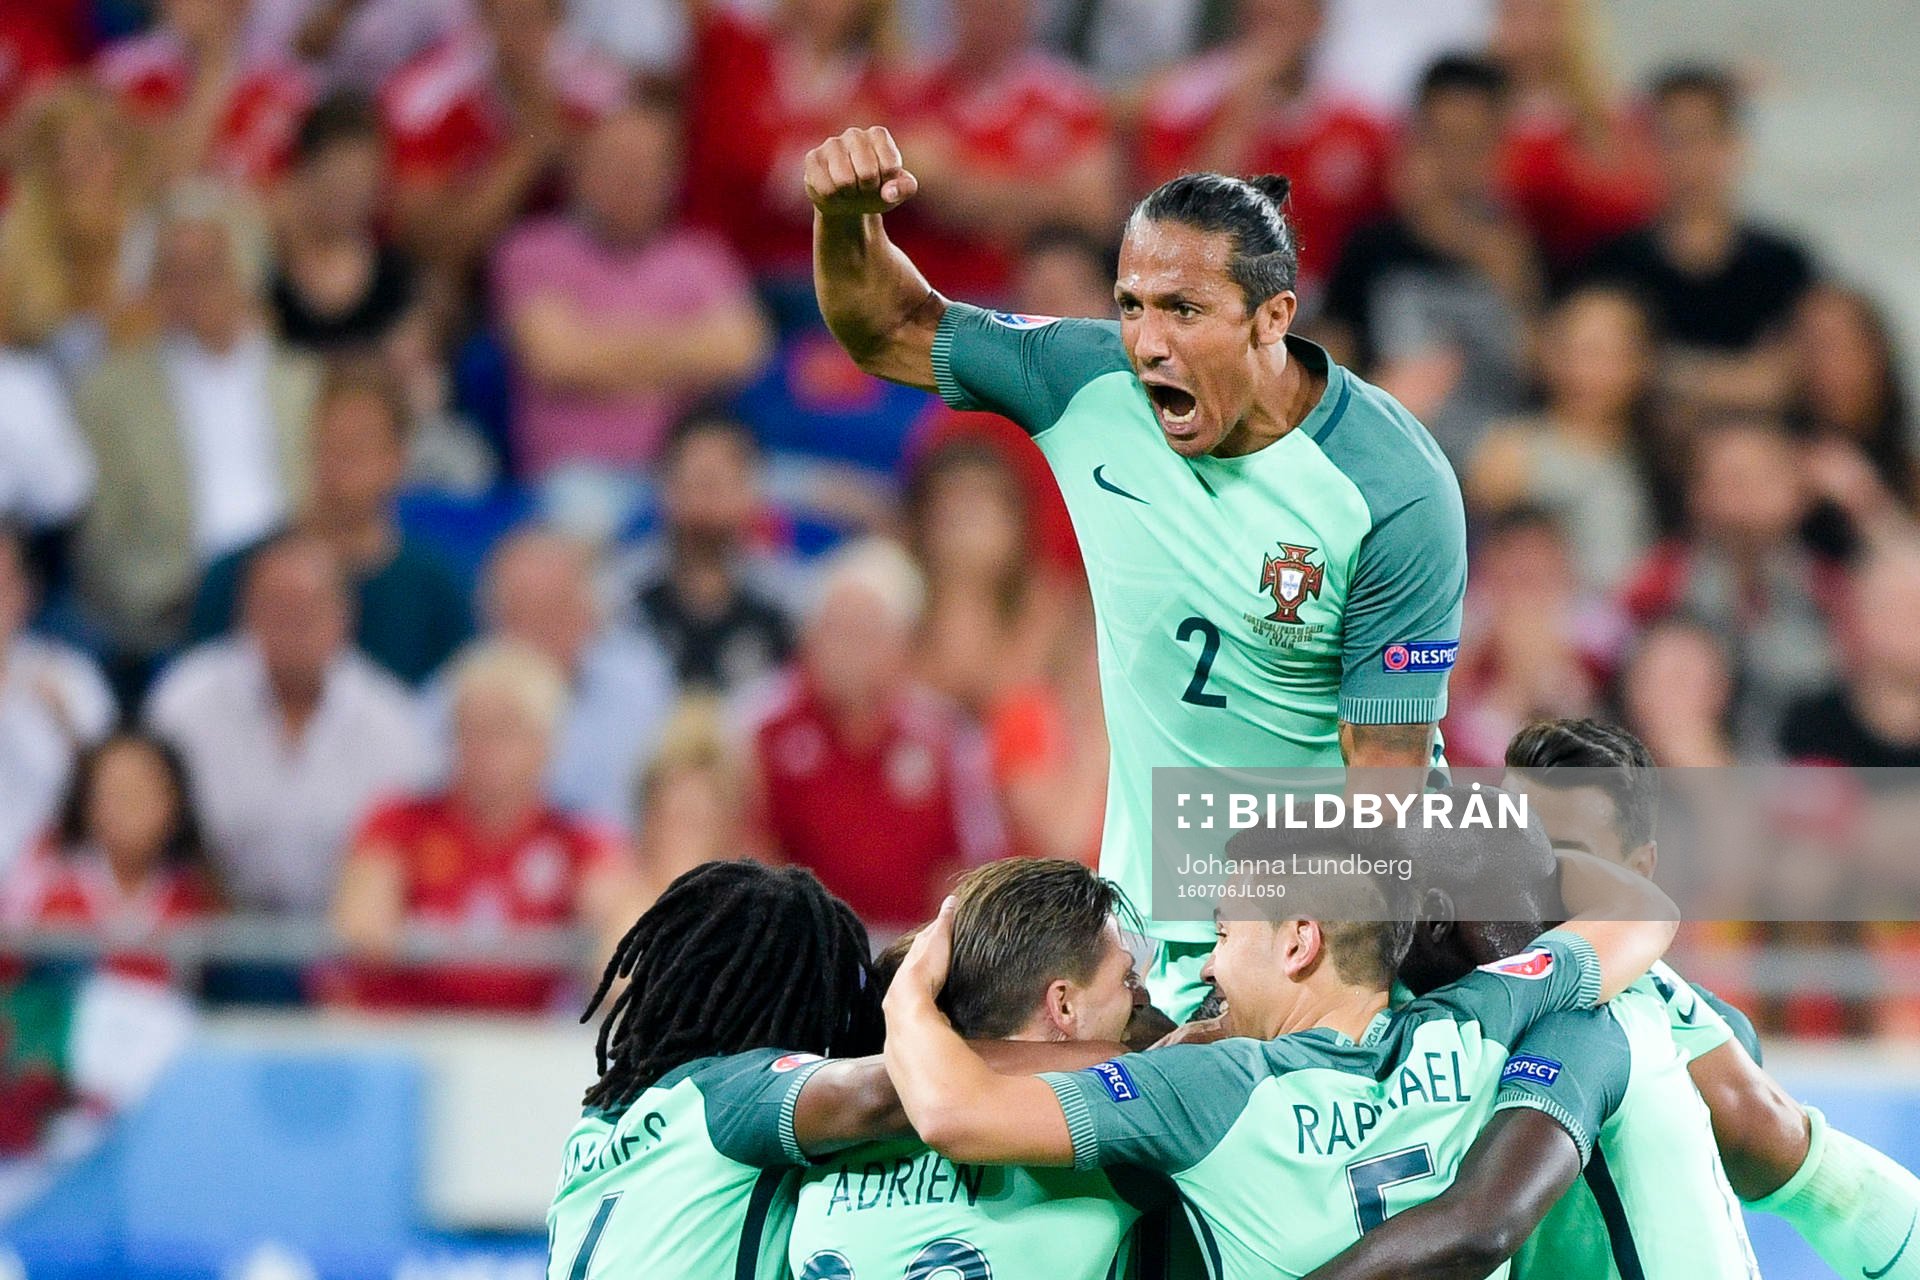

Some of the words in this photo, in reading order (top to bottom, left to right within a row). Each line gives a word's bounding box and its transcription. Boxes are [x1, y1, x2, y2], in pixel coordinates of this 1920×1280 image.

[1176, 617, 1227, 709] 2
[1410, 647, 1459, 664] RESPEC
[1292, 1051, 1472, 1155] RAPAEL
[827, 1153, 986, 1216] ADRIEN
